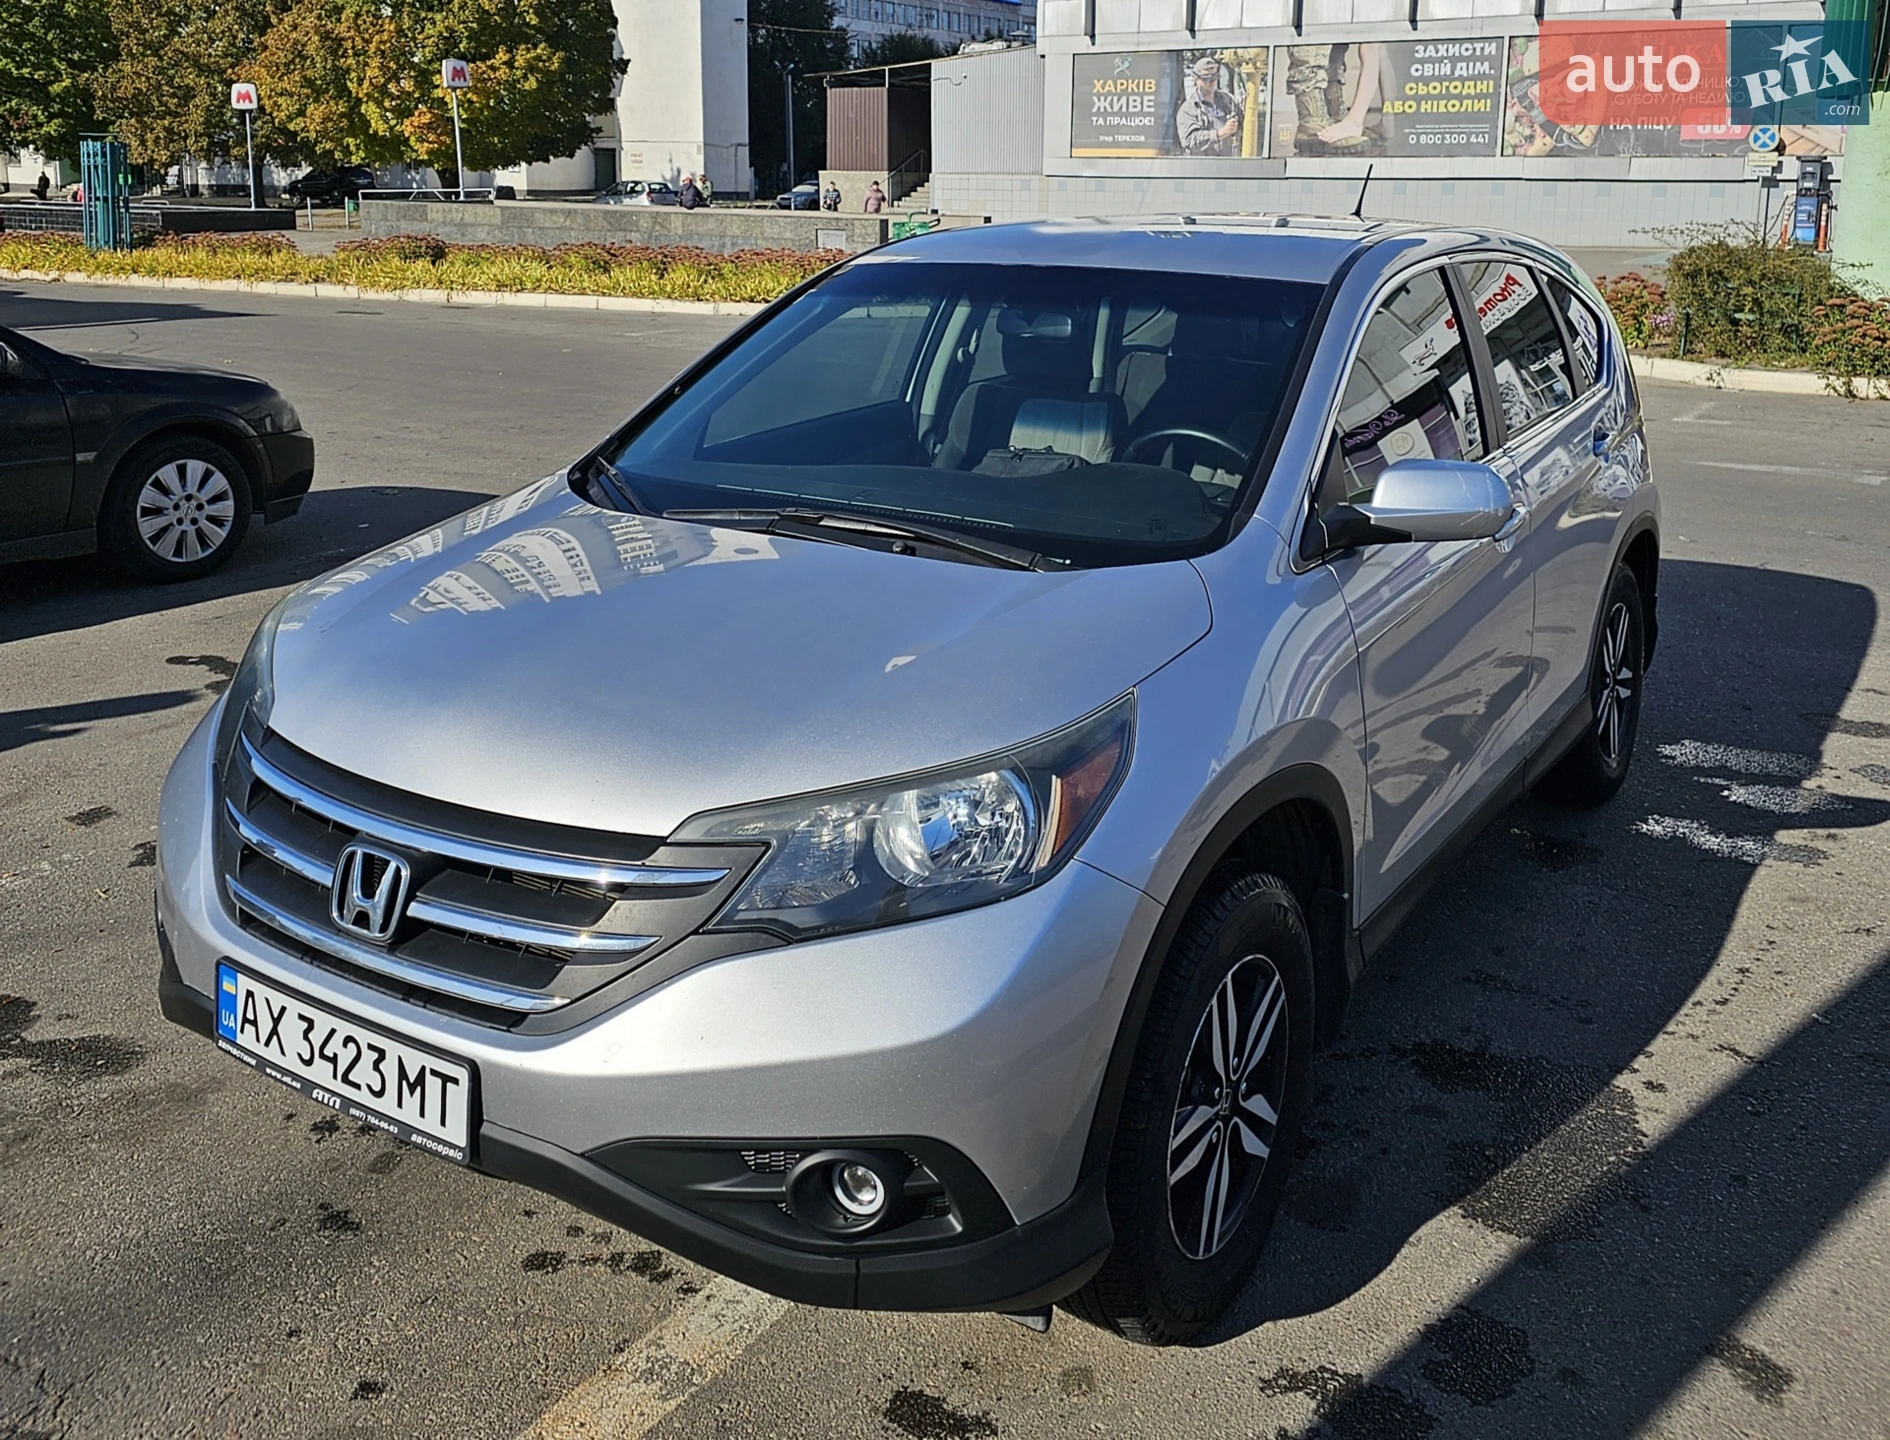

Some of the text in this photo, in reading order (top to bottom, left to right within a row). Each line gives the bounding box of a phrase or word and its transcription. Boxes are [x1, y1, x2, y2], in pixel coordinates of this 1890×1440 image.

[1414, 42, 1497, 58] ЗАХИСТИ
[1410, 60, 1495, 77] СВІЙ ДІМ.
[1093, 78, 1156, 93] ХАРКІВ
[1404, 80, 1494, 95] СЬОГОДНІ
[1091, 95, 1155, 112] ЖИВЕ
[1382, 98, 1491, 113] АБО НІКОЛИ!
[1614, 93, 1668, 105] СУБОТУ
[1671, 92, 1686, 104] ТА
[1091, 116, 1154, 127] ТА ПРАЦЮЄ!
[1609, 116, 1676, 131] НА ПІЦУ
[1114, 134, 1145, 142] ТЕРЕХОВ
[1409, 134, 1489, 144] 0 800 300 441
[221, 1009, 235, 1031] UA
[239, 988, 460, 1129] AX 3423 MT
[410, 1133, 463, 1160] автосервіс
